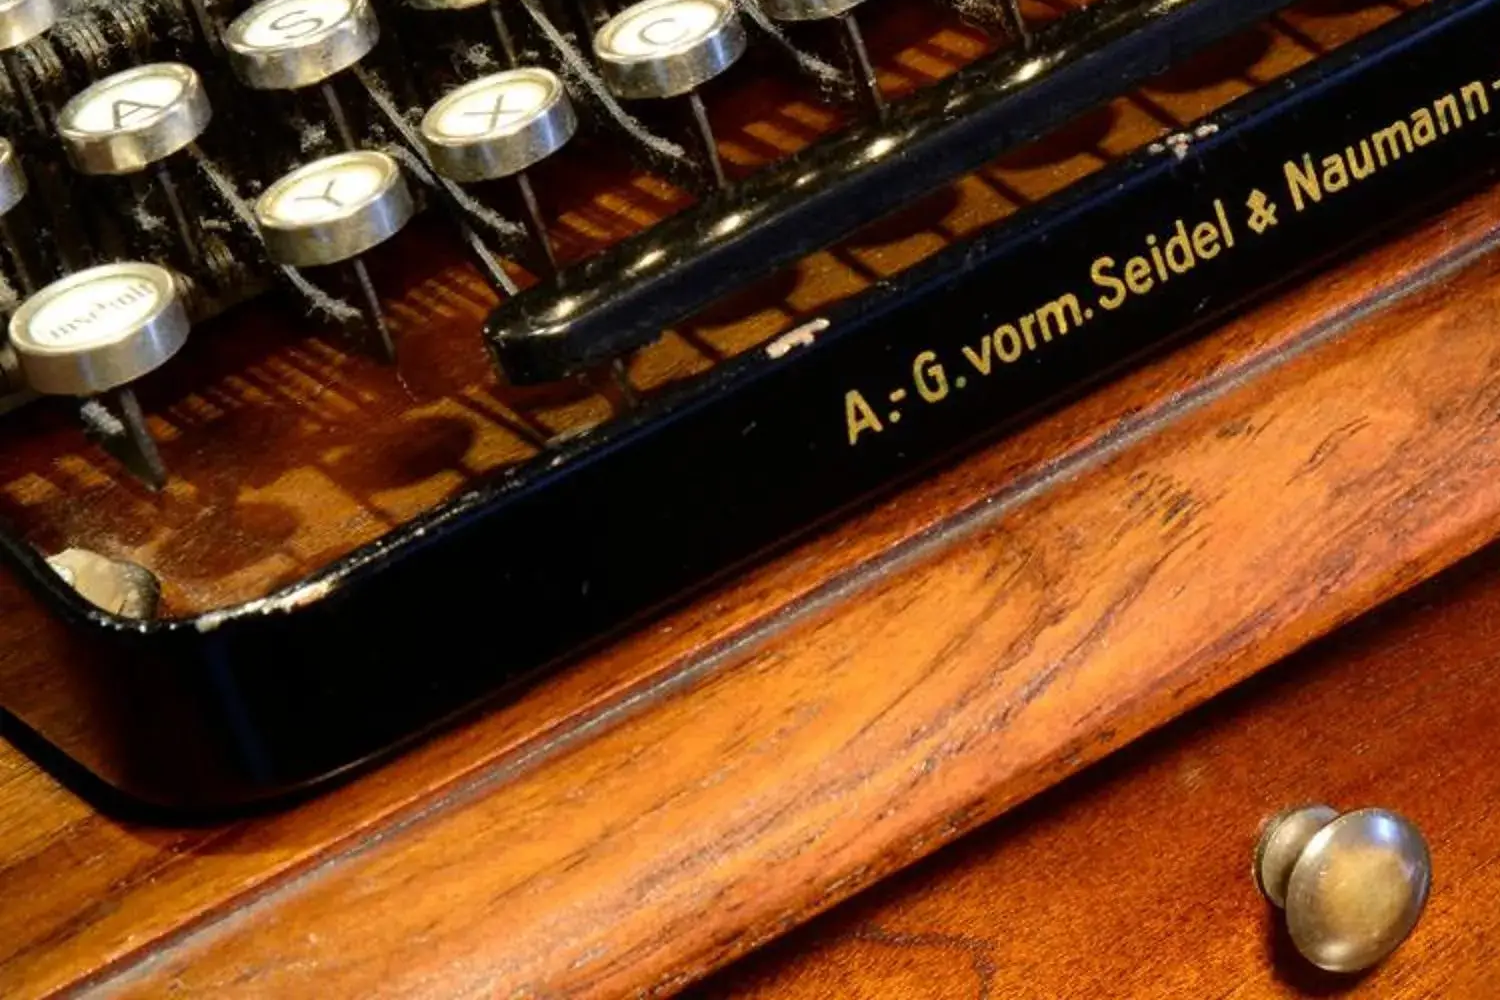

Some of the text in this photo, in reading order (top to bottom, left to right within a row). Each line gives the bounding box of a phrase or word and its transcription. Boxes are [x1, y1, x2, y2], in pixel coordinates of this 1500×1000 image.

[268, 9, 324, 40] S
[638, 17, 692, 45] C
[112, 99, 168, 130] A
[462, 94, 523, 134] X
[294, 179, 344, 208] Y
[962, 292, 1094, 376] vorm.
[1090, 198, 1235, 311] Seidel
[1246, 188, 1279, 235] &
